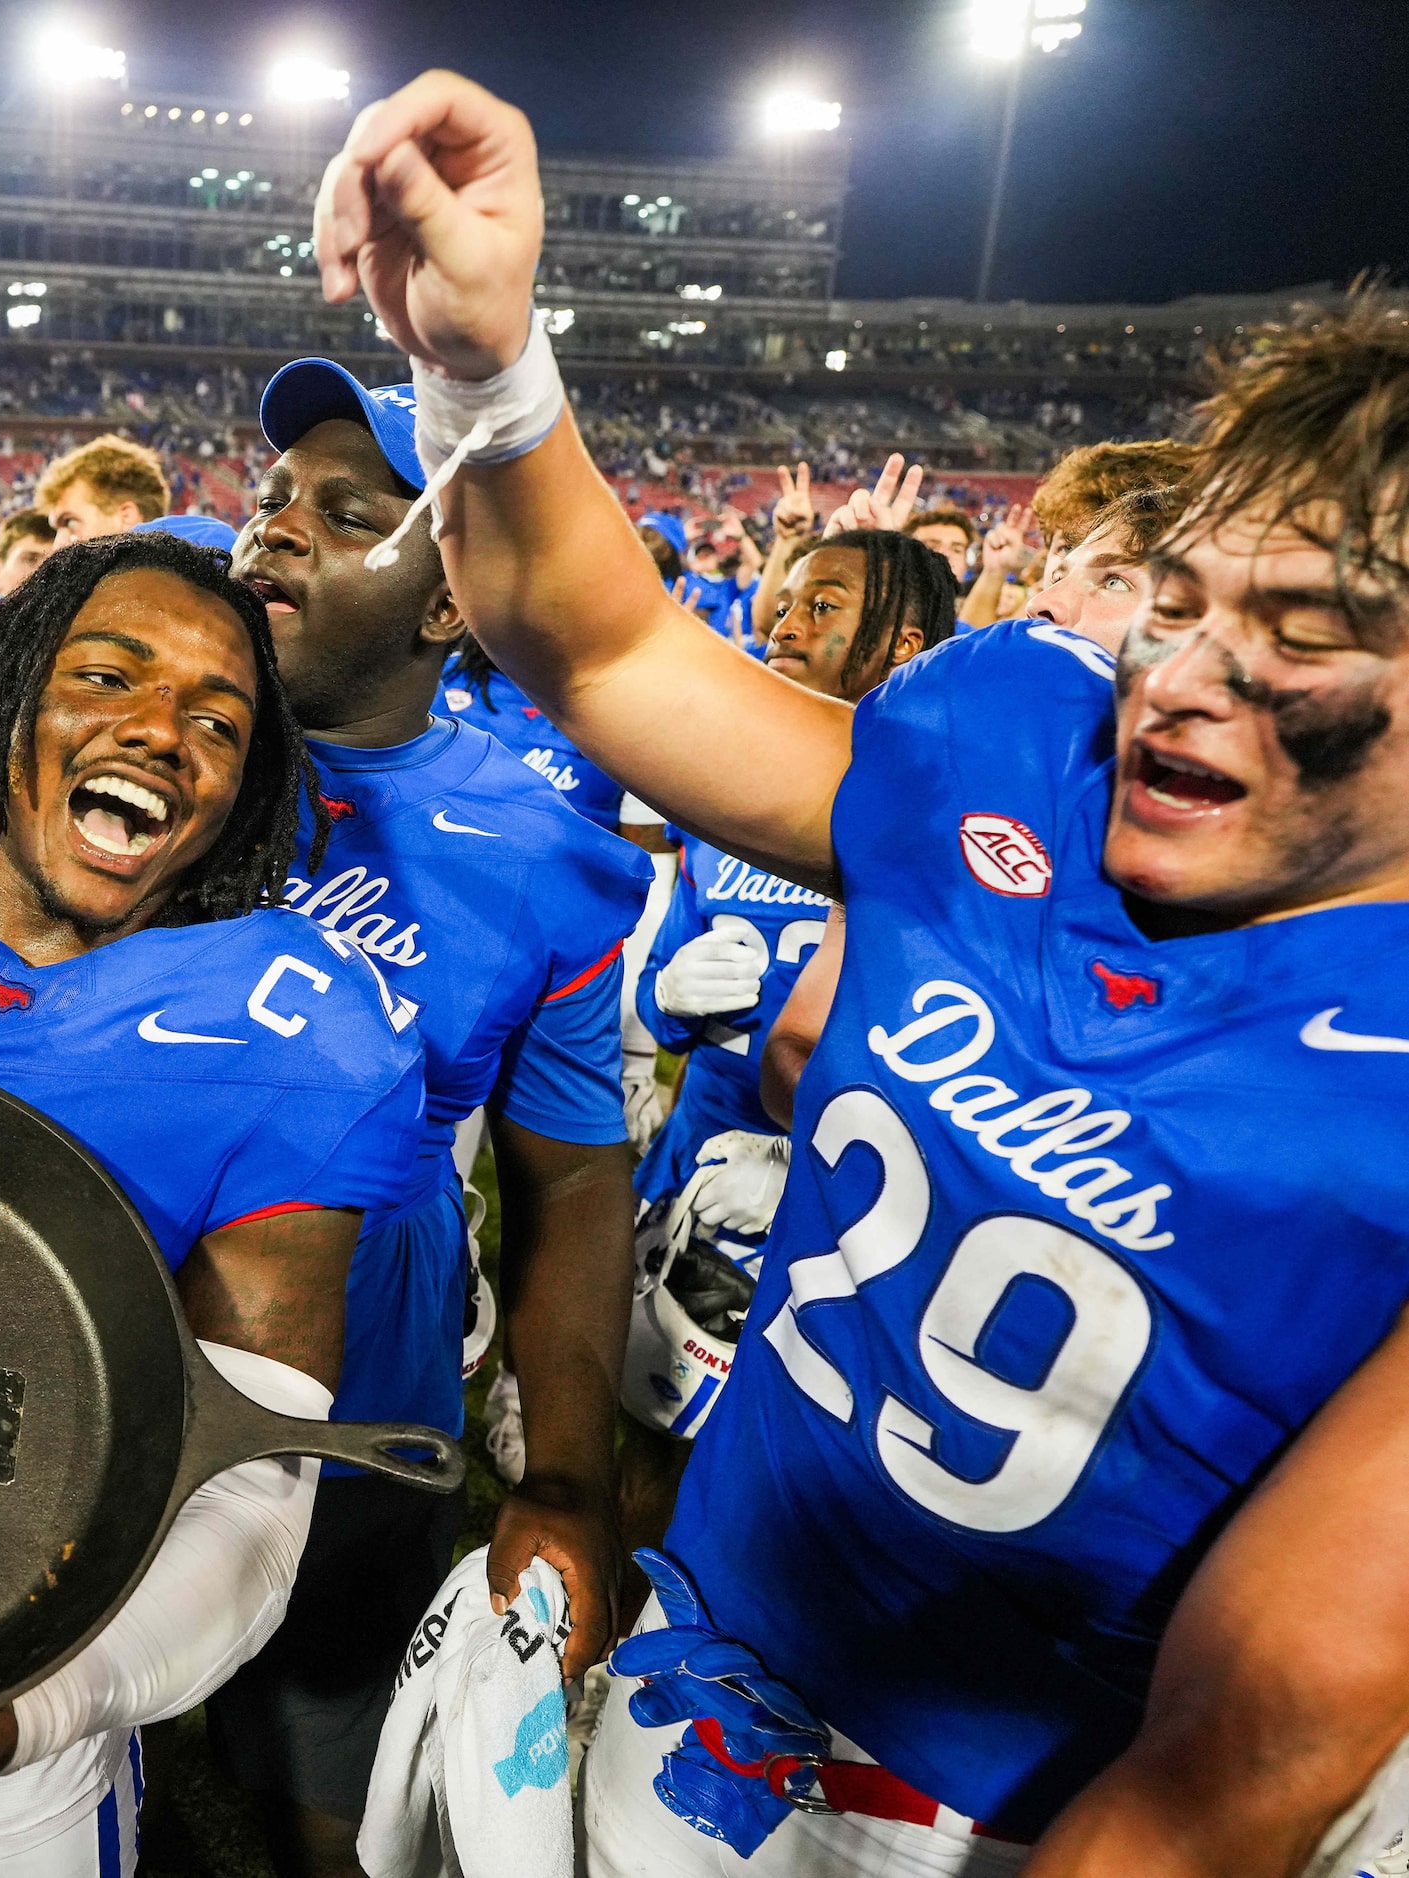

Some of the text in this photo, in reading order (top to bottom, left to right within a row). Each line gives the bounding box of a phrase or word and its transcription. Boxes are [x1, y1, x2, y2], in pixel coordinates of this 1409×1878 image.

[972, 831, 1046, 882] ACC
[261, 866, 427, 967] allas
[248, 954, 333, 1039] C
[868, 980, 1175, 1252] Dallas
[762, 1090, 1152, 1533] 29
